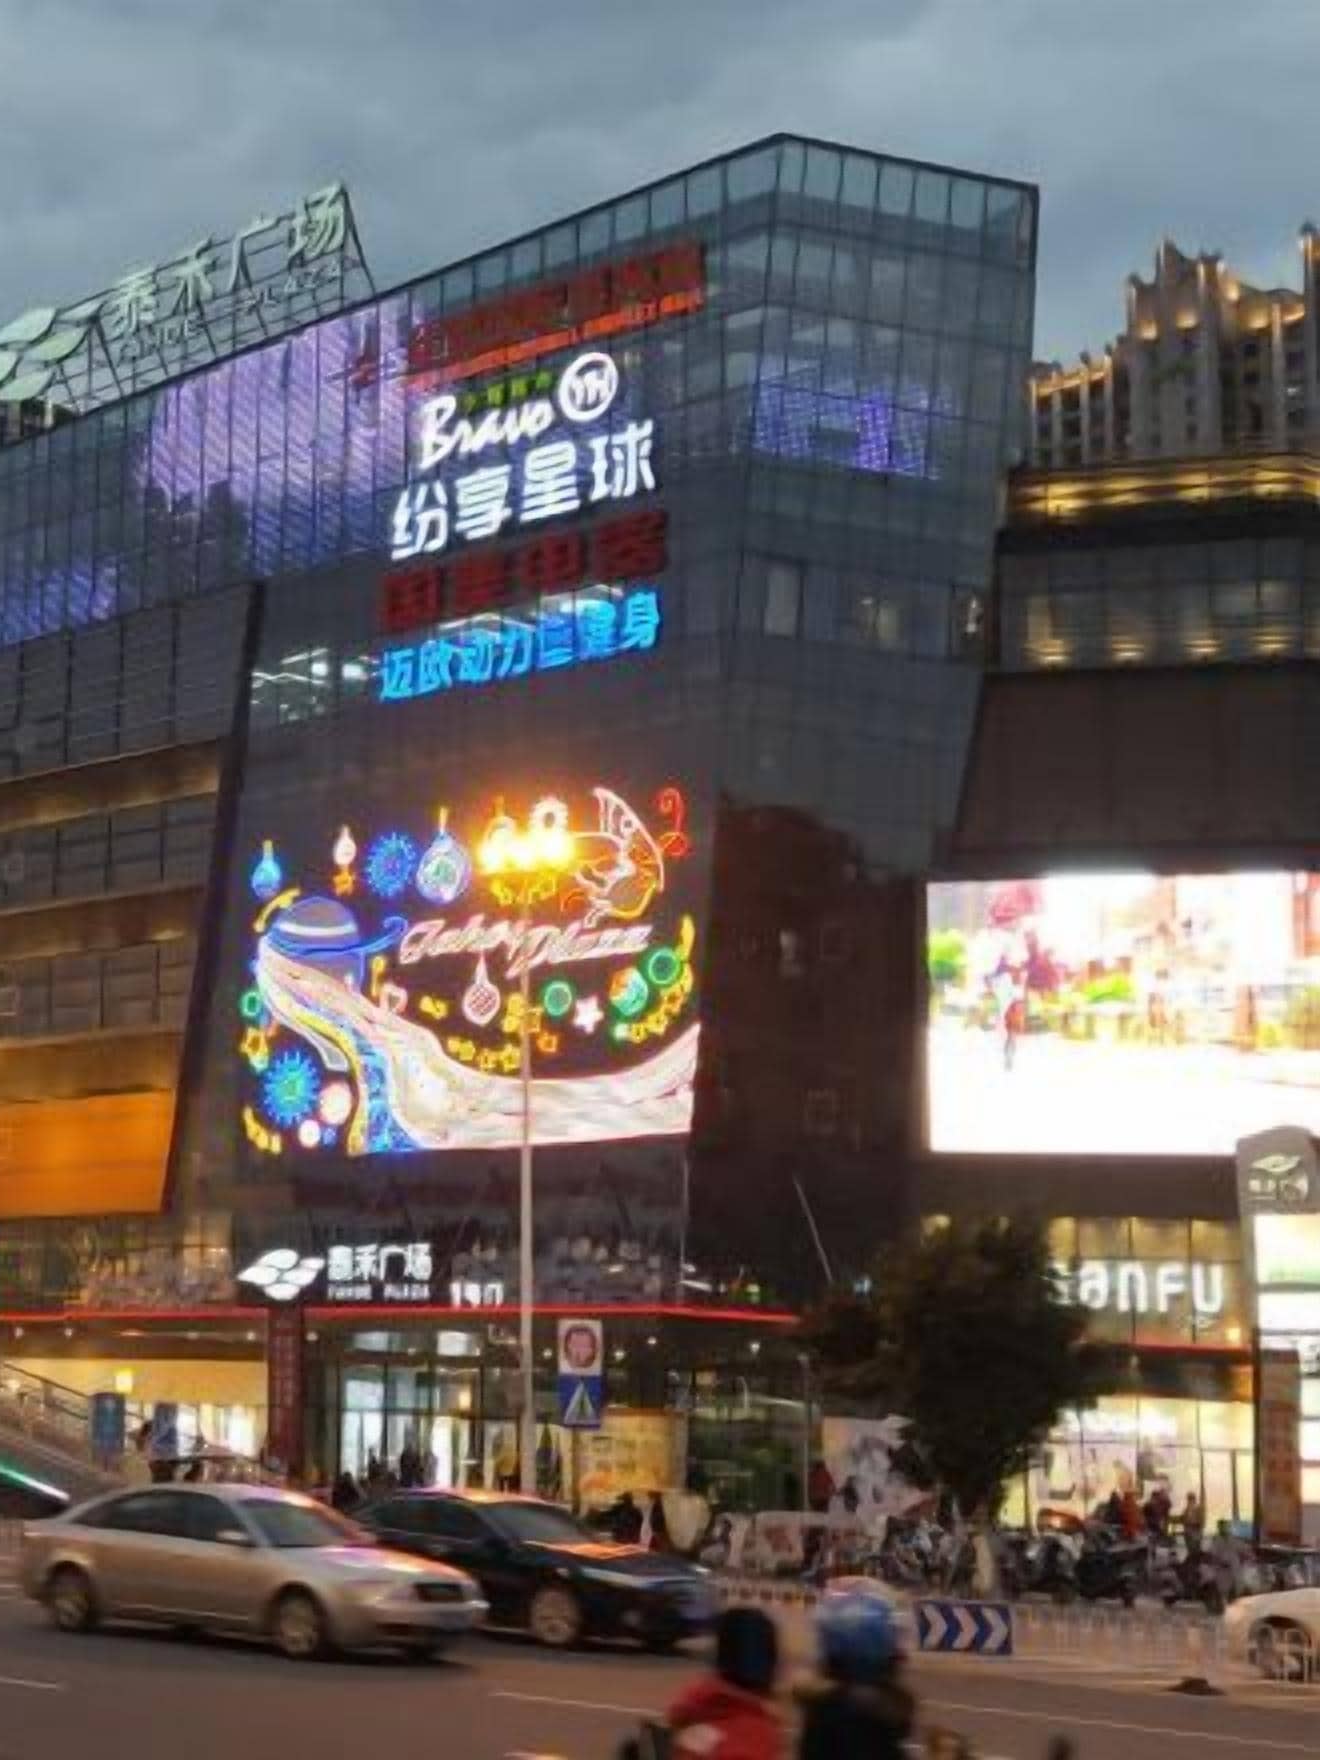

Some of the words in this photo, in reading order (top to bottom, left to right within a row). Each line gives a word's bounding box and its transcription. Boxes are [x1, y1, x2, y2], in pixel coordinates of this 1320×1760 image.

[418, 394, 556, 470] Bravo
[390, 420, 657, 561] 纷享星球
